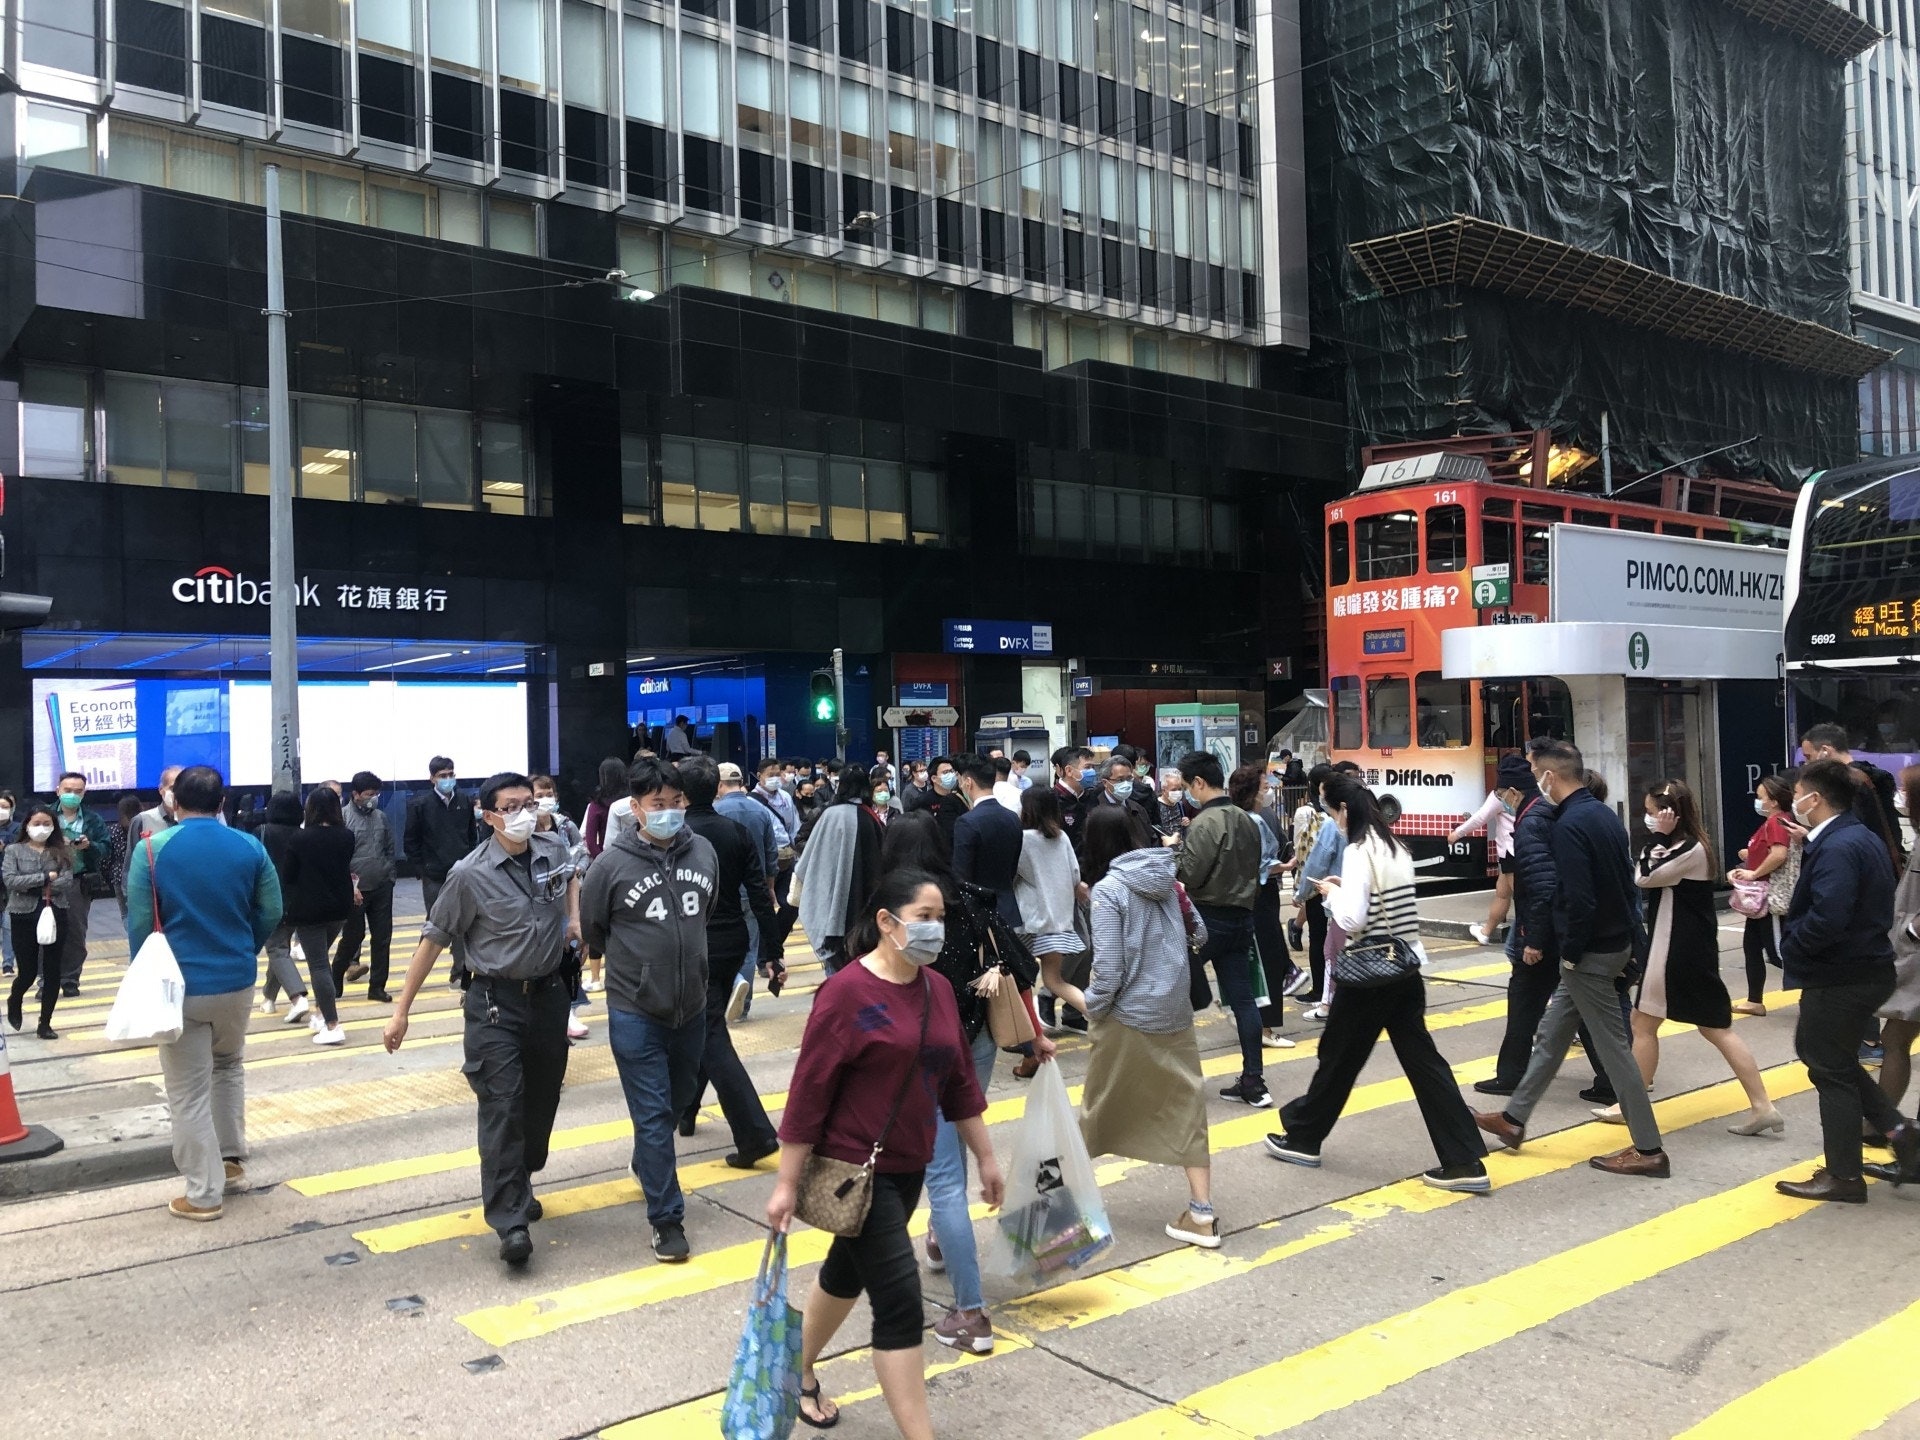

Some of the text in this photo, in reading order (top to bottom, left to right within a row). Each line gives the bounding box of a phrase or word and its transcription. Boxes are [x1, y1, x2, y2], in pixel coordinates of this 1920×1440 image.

[1380, 457, 1422, 483] 161
[1433, 489, 1457, 504] 161
[1330, 507, 1343, 521] 161
[171, 565, 448, 612] citibak 花旗銀行
[1333, 585, 1460, 618] 喉嚨發炎腫痛?
[1851, 625, 1869, 638] via
[1875, 621, 1909, 637] Mong
[999, 636, 1030, 650] DVFX
[1811, 633, 1836, 645] 5692
[639, 677, 669, 695] citibank
[73, 712, 136, 732] 財經快
[1385, 768, 1453, 787] Difflam
[1447, 842, 1471, 856] 161
[645, 890, 700, 921] 4 8
